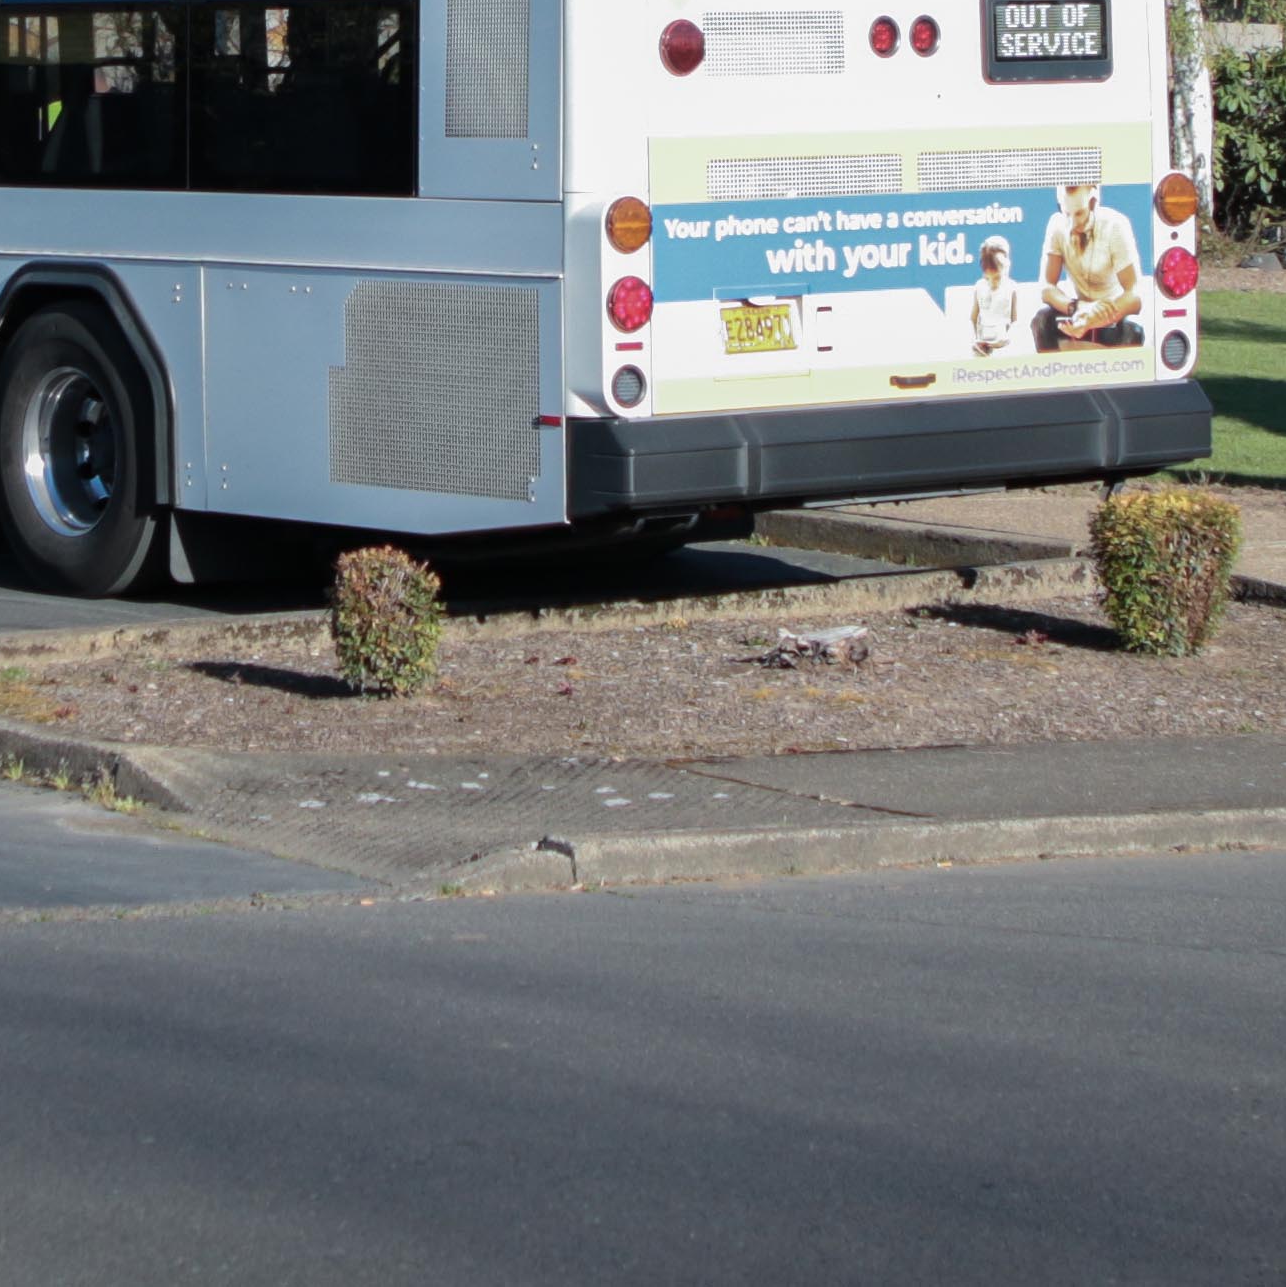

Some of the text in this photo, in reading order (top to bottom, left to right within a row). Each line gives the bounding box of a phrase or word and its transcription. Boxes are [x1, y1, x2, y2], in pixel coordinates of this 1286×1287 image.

[1005, 4, 1090, 28] OUT OF
[1001, 32, 1098, 56] SERVICE
[664, 203, 1023, 241] Your phone can't have a conversation
[766, 232, 974, 278] with your kid.
[952, 358, 1145, 384] iRespectAndProtect.com
